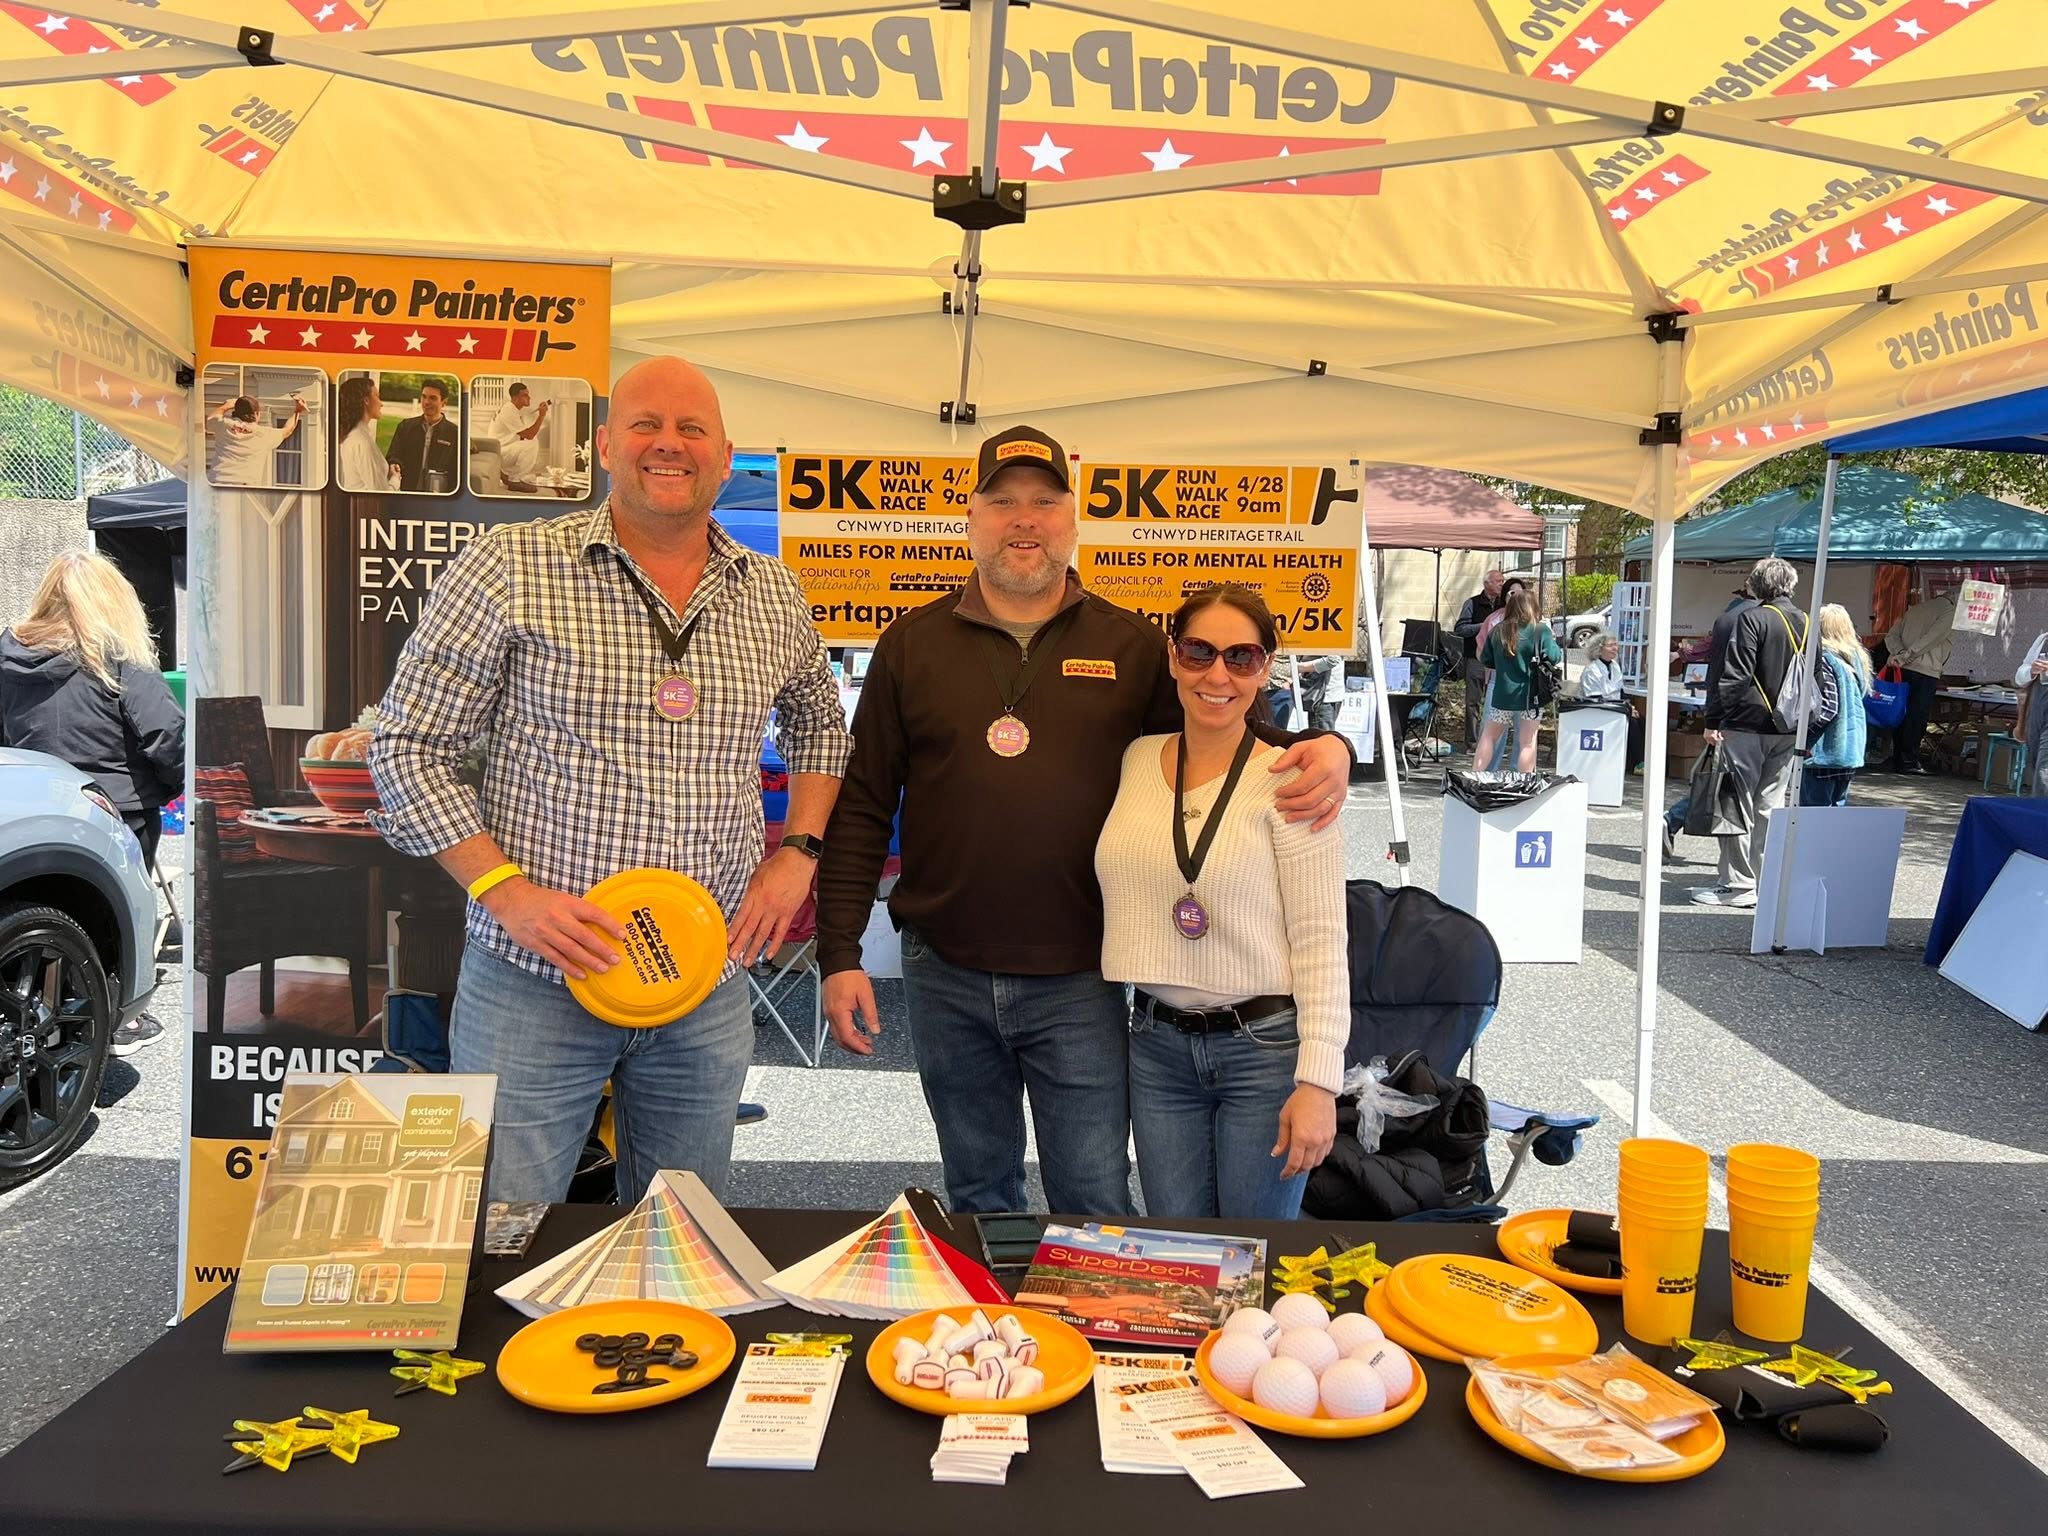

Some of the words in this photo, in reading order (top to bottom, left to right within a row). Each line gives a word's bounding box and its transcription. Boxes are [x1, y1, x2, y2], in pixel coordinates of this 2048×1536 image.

[219, 269, 396, 316] CertaPro
[408, 279, 577, 324] Painters
[789, 457, 875, 510] 5K
[880, 460, 920, 476] RUN
[879, 478, 933, 494] WALK
[1087, 467, 1172, 519] 5K
[1176, 469, 1216, 484] RUN
[1237, 475, 1284, 494] 4/28
[1175, 487, 1229, 502] WALK
[1237, 497, 1281, 514] 9am
[880, 496, 926, 511] RACE
[1176, 504, 1221, 519] RACE
[837, 519, 903, 533] CYNWYD
[360, 518, 507, 552] INTER
[1132, 527, 1197, 541] CYNWYD
[1200, 529, 1264, 542] HERITAGE
[1267, 530, 1304, 543] TRAIL
[799, 543, 853, 560] MILES
[859, 544, 895, 560] FOR
[1094, 551, 1147, 567] MILES
[1153, 552, 1189, 567] FOR
[1194, 553, 1267, 568] MENTAL
[1273, 555, 1343, 569] HEALTH
[800, 567, 847, 578] COUNCIL
[849, 568, 871, 578] FOR
[891, 571, 931, 582] CertaPro
[1094, 575, 1140, 586] COUNCIL
[1142, 576, 1163, 586] FOR
[663, 691, 677, 701] 5K
[640, 906, 662, 944] CertaPro
[660, 944, 681, 980] Painters
[1110, 1357, 1144, 1368] 5K
[1118, 1381, 1157, 1396] 5K
